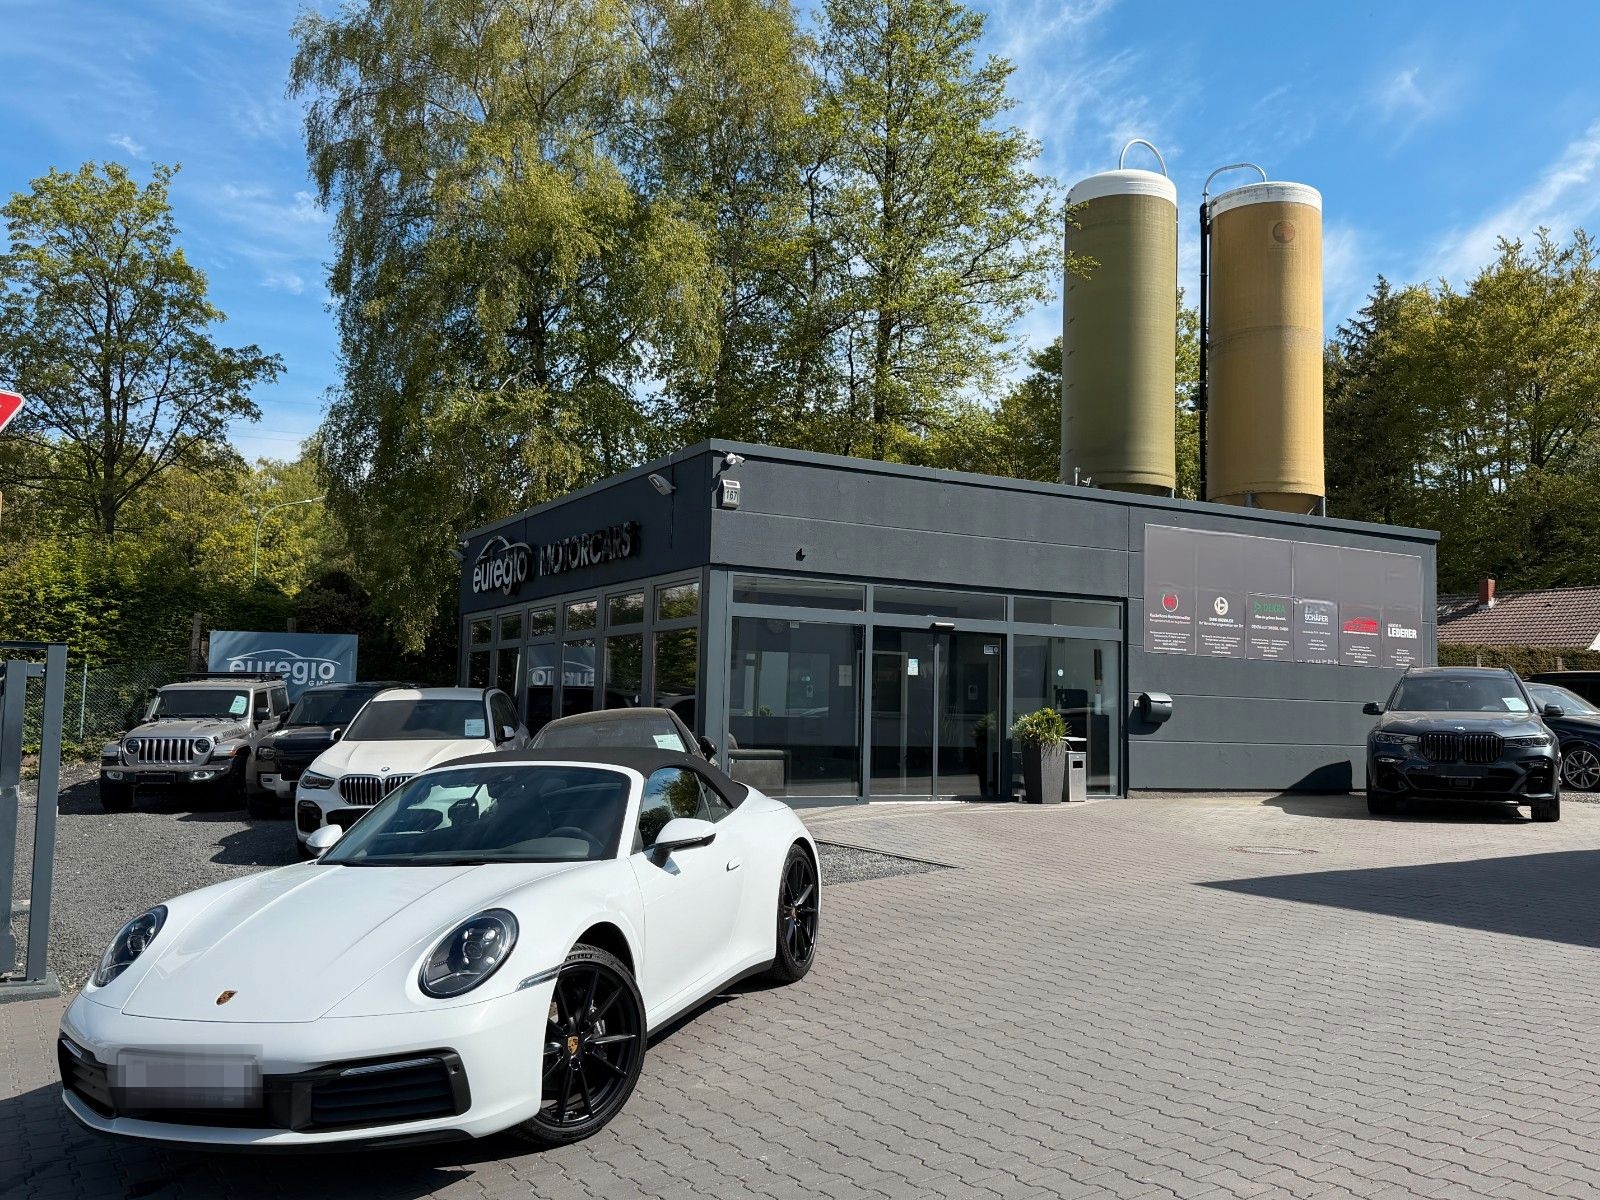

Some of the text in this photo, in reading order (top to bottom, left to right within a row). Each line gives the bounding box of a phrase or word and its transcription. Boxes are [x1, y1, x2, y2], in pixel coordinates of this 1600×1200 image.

[726, 489, 738, 500] 167
[473, 522, 633, 595] euregio MOTORCARS
[1304, 613, 1329, 623] SCHÄFER
[1387, 627, 1417, 639] LEDERER
[229, 660, 336, 685] euregio
